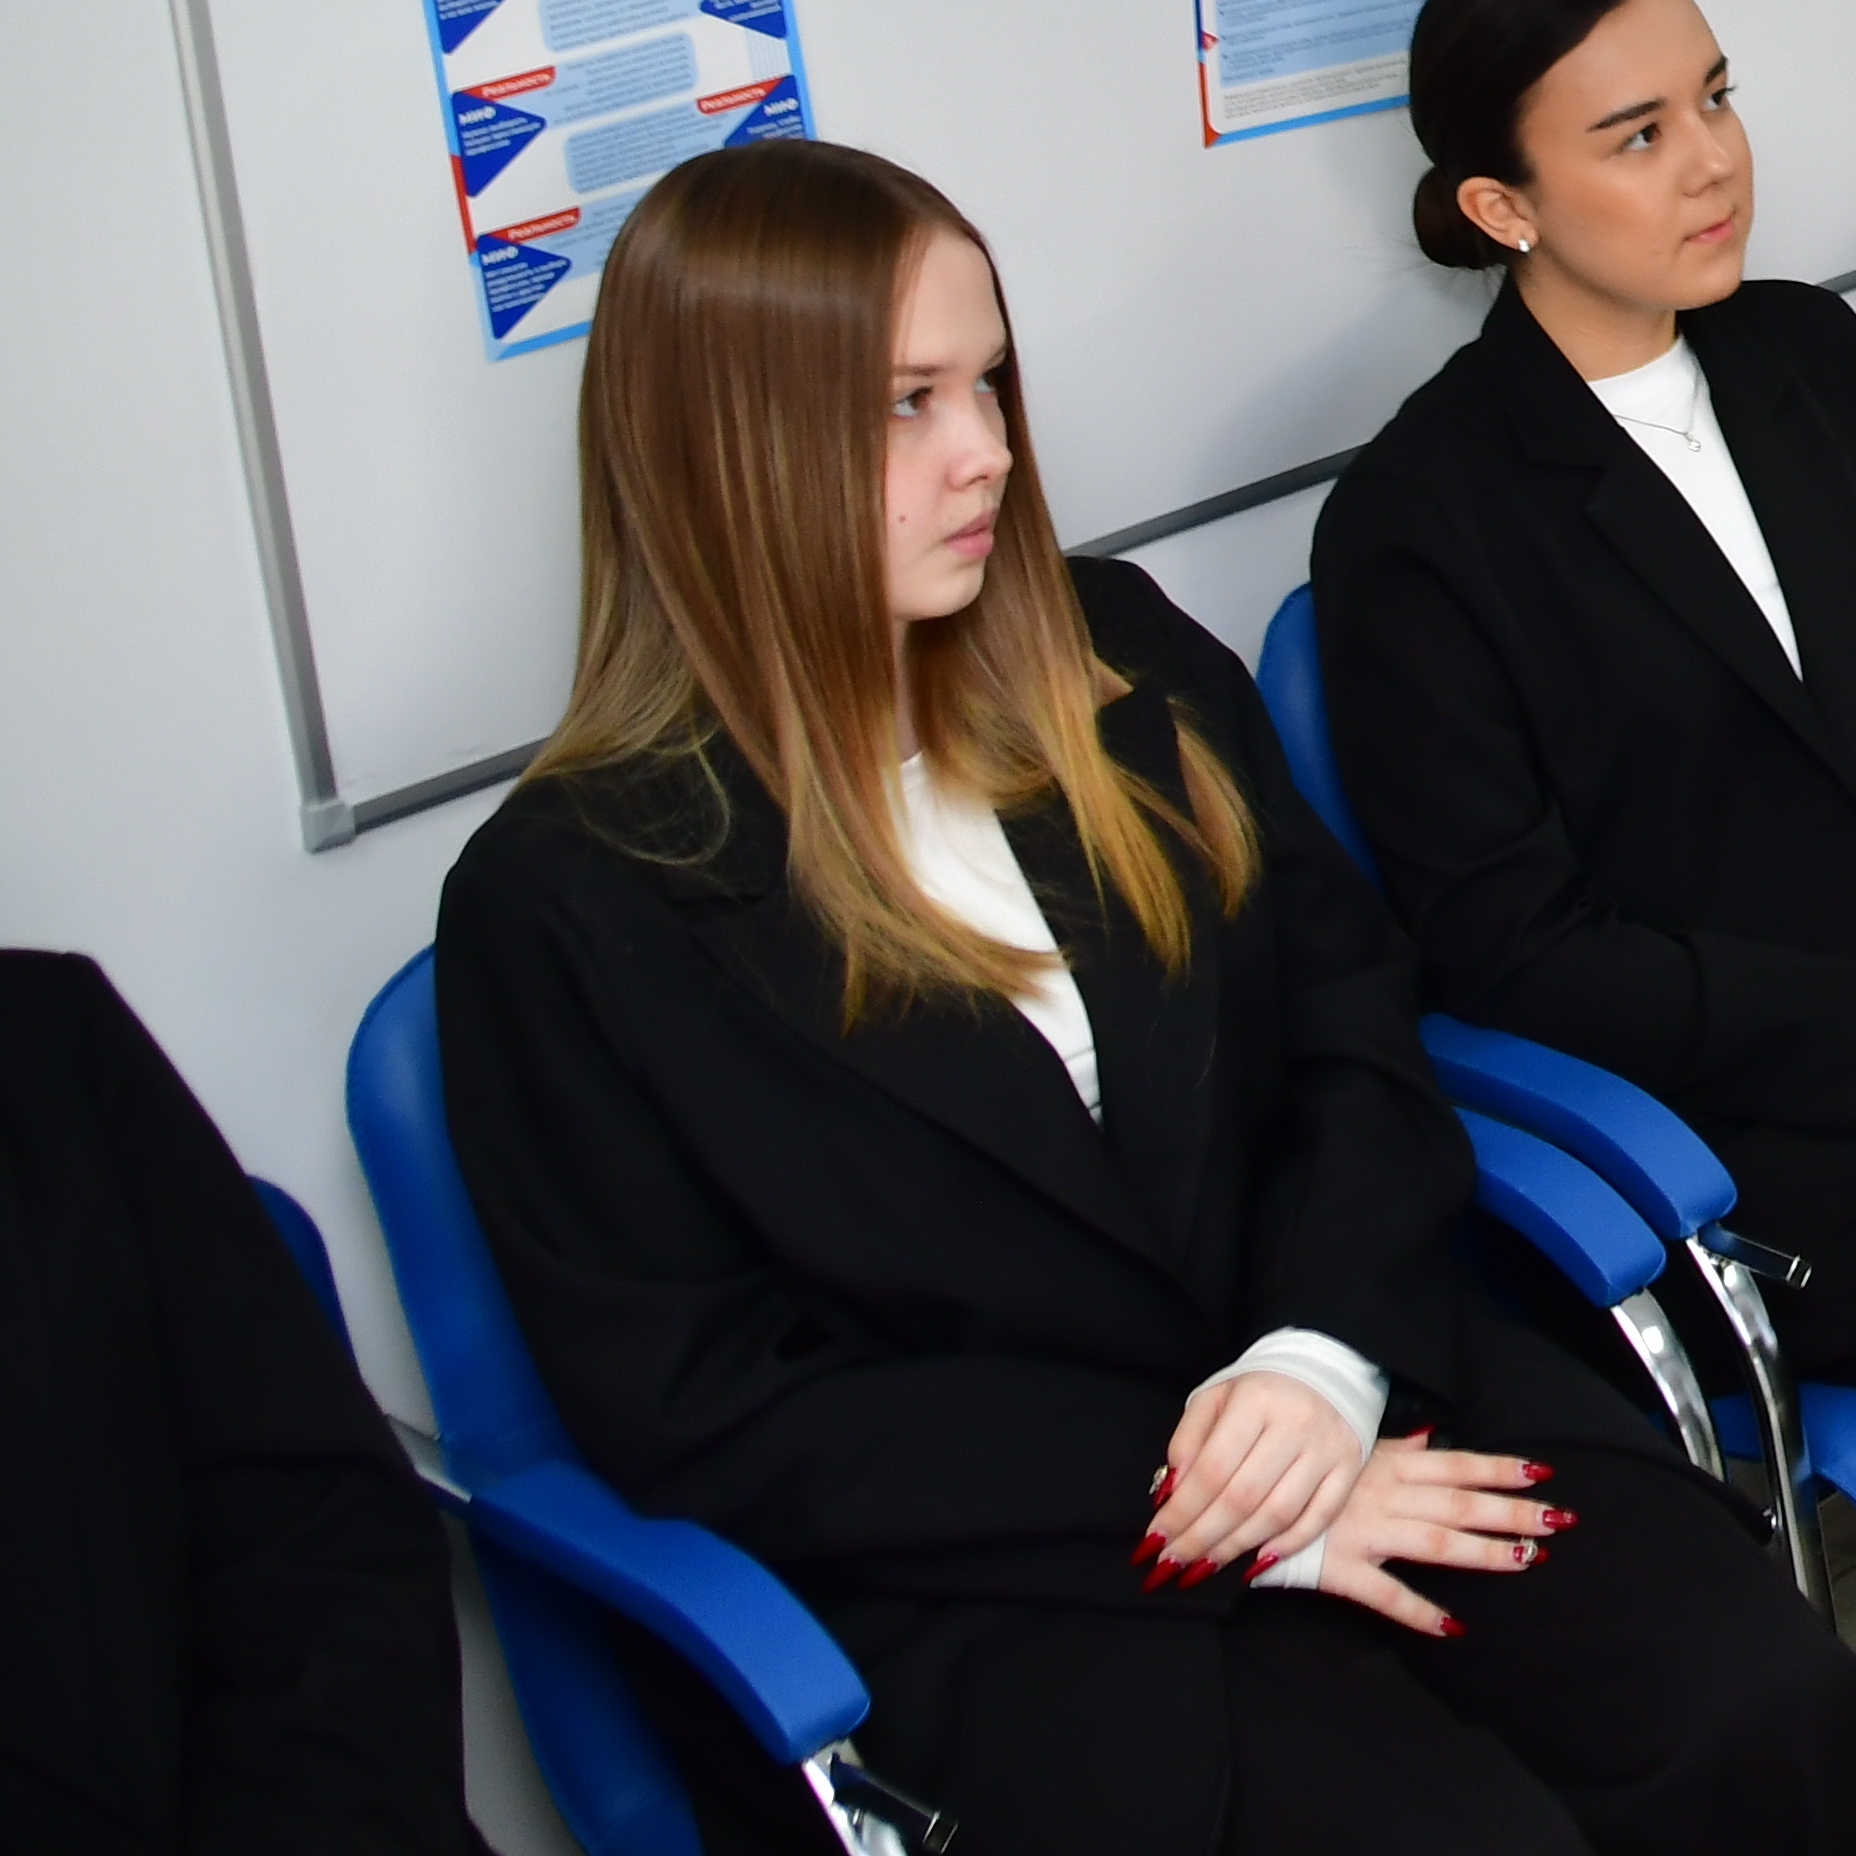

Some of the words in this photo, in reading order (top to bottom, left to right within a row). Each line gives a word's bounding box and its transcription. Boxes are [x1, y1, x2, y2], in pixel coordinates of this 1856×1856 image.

[480, 73, 551, 98] Реальность
[700, 86, 767, 112] Реальность
[763, 97, 800, 117] МИФ
[457, 105, 497, 126] МИФ
[506, 214, 577, 240] Реальность
[481, 245, 519, 267] МИФ
